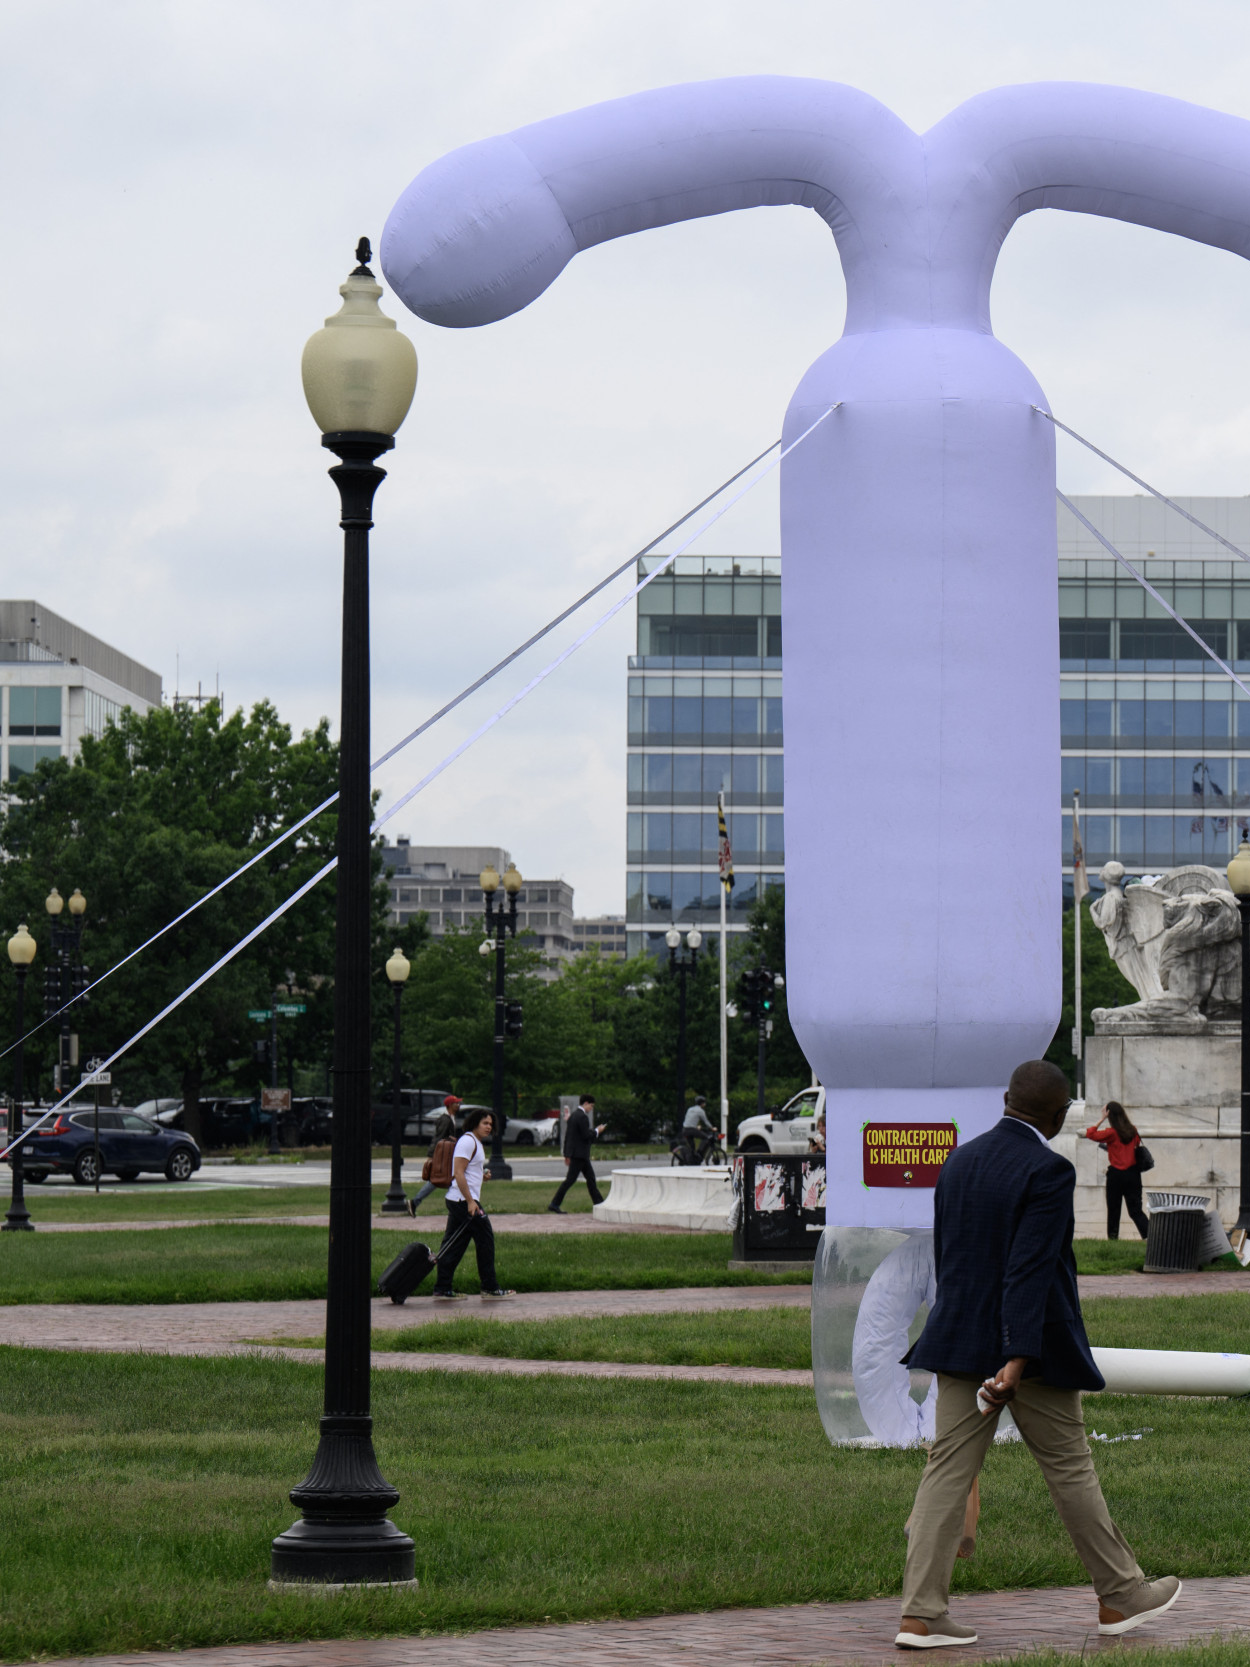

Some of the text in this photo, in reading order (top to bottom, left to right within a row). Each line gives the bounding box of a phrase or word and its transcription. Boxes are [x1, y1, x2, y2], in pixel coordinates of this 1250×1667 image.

[866, 1129, 954, 1146] CONTRACEPTION
[870, 1148, 879, 1165] IS
[880, 1148, 920, 1165] HEALTH
